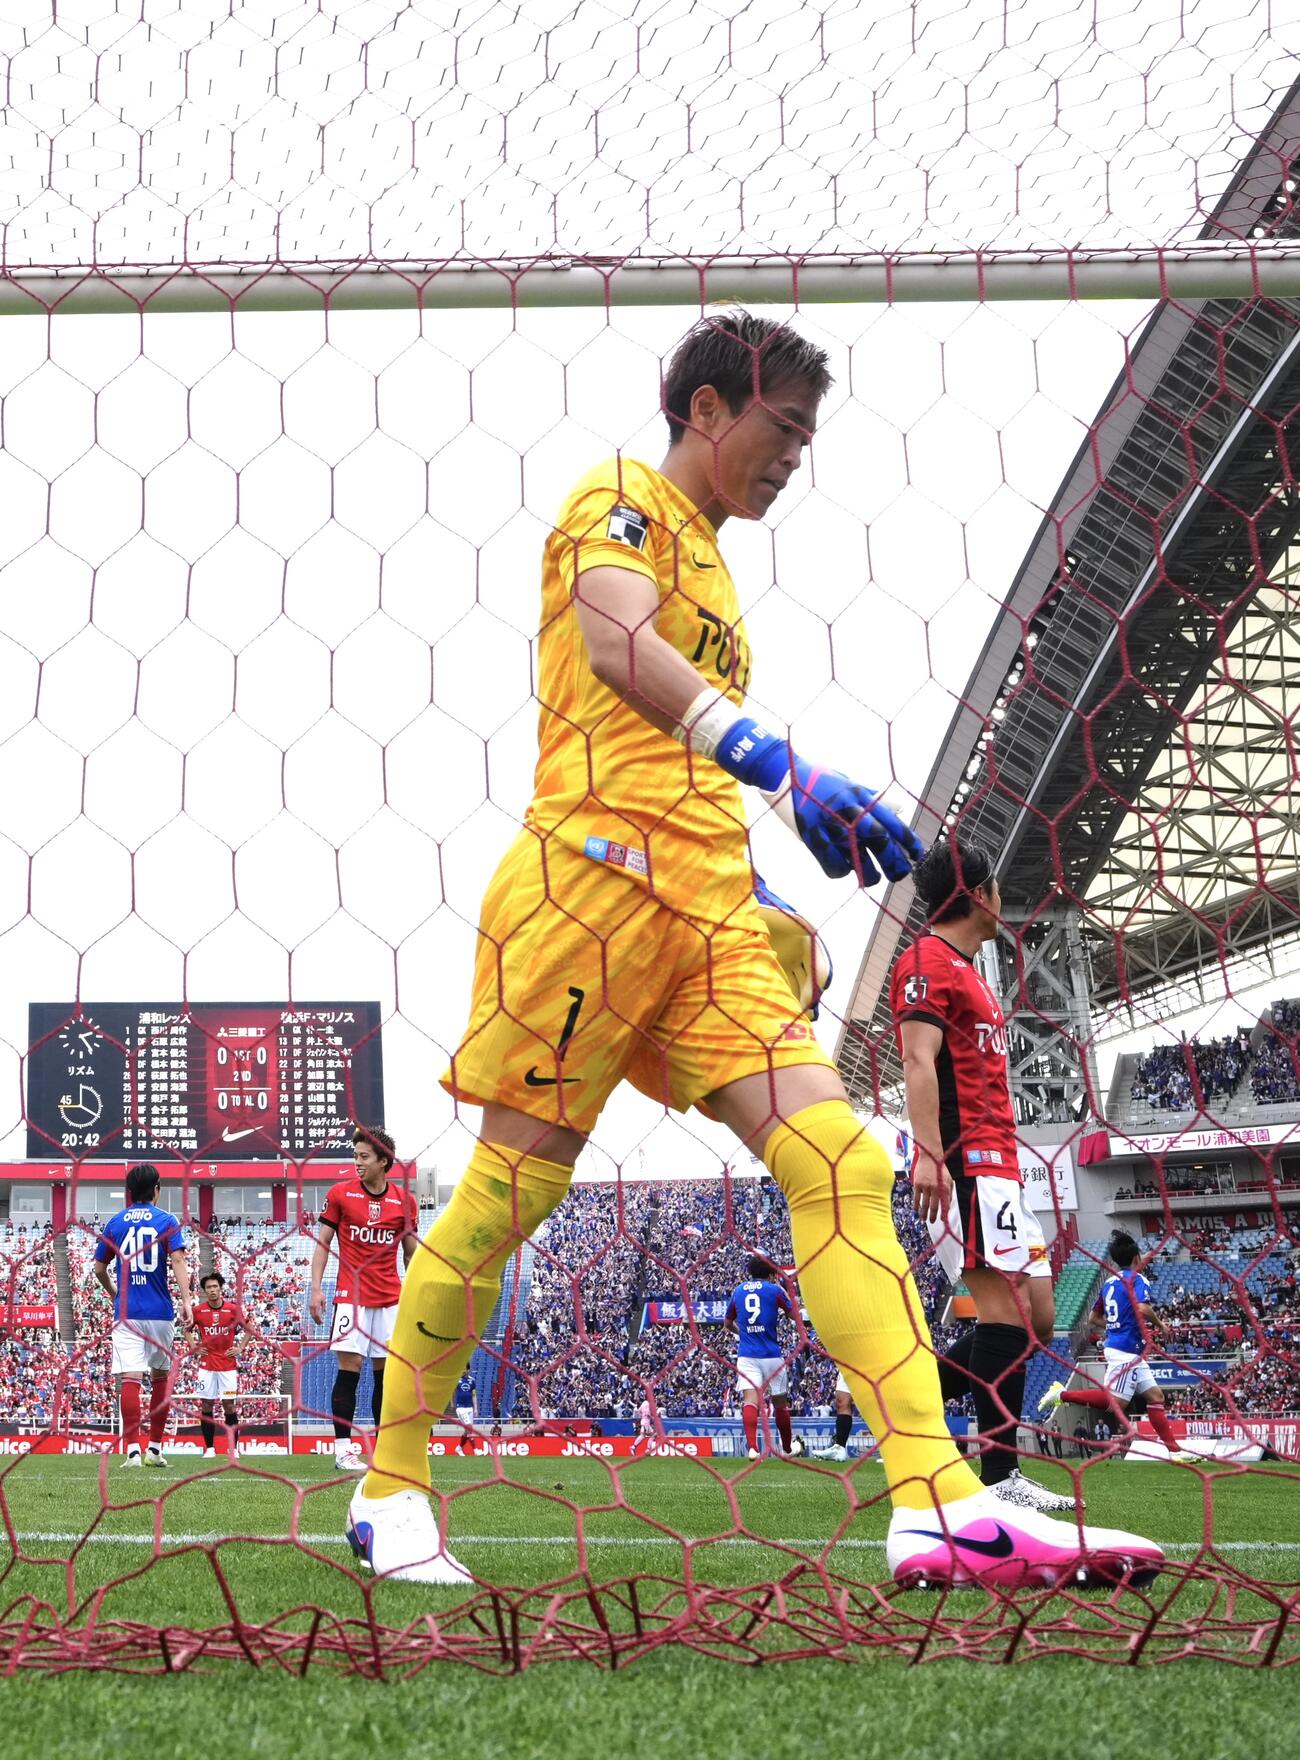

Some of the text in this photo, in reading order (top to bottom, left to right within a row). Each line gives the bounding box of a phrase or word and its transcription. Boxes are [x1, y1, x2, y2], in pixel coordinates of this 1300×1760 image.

[139, 1012, 192, 1024] 浦和レッズ
[558, 986, 584, 1062] 1
[138, 1026, 146, 1034] GK
[170, 1026, 187, 1035] 周作
[281, 1026, 284, 1034] 1
[125, 1038, 130, 1046] 4
[138, 1038, 146, 1046] DF
[151, 1037, 168, 1046] 石原
[279, 1037, 287, 1045] 13
[293, 1037, 301, 1045] DF
[306, 1037, 323, 1045] 井上
[217, 1047, 227, 1064] 0
[257, 1047, 266, 1064] 0
[293, 1048, 302, 1056] DF
[125, 1060, 129, 1068] 5
[138, 1060, 146, 1068] DF
[279, 1060, 288, 1068] 22
[294, 1060, 302, 1068] DF
[307, 1059, 323, 1068] 角田
[68, 1066, 94, 1076] リズム
[138, 1072, 146, 1080] DF
[281, 1071, 286, 1079] 2
[294, 1071, 302, 1079] DF
[282, 1083, 286, 1091] 6
[60, 1095, 72, 1104] 45
[123, 1094, 131, 1102] 22
[218, 1092, 267, 1109] 0 TOAL 0
[123, 1106, 131, 1114] 77
[151, 1105, 168, 1114] 金子
[308, 1105, 325, 1114] 天野
[123, 1129, 132, 1137] 36
[282, 1129, 287, 1137] 9
[309, 1128, 326, 1137] 谷村
[62, 1134, 99, 1146] 20:42
[123, 1140, 132, 1149] 45
[281, 1140, 289, 1148] 30
[1123, 1128, 1270, 1151] イオンモール浦和美園
[997, 1201, 1017, 1240] 4
[350, 1225, 395, 1244] POLUS
[120, 1227, 158, 1272] 40
[131, 1275, 147, 1285] JUN
[745, 1294, 760, 1324] 9
[1105, 1286, 1118, 1322] 6
[339, 1315, 350, 1336] 2
[204, 1326, 229, 1336] POLUS
[1132, 1367, 1138, 1381] 6
[62, 1438, 115, 1454] Juice
[310, 1440, 362, 1455] Jue
[475, 1442, 529, 1456] Juice
[561, 1442, 614, 1456] Juice
[650, 1442, 698, 1456] Juice
